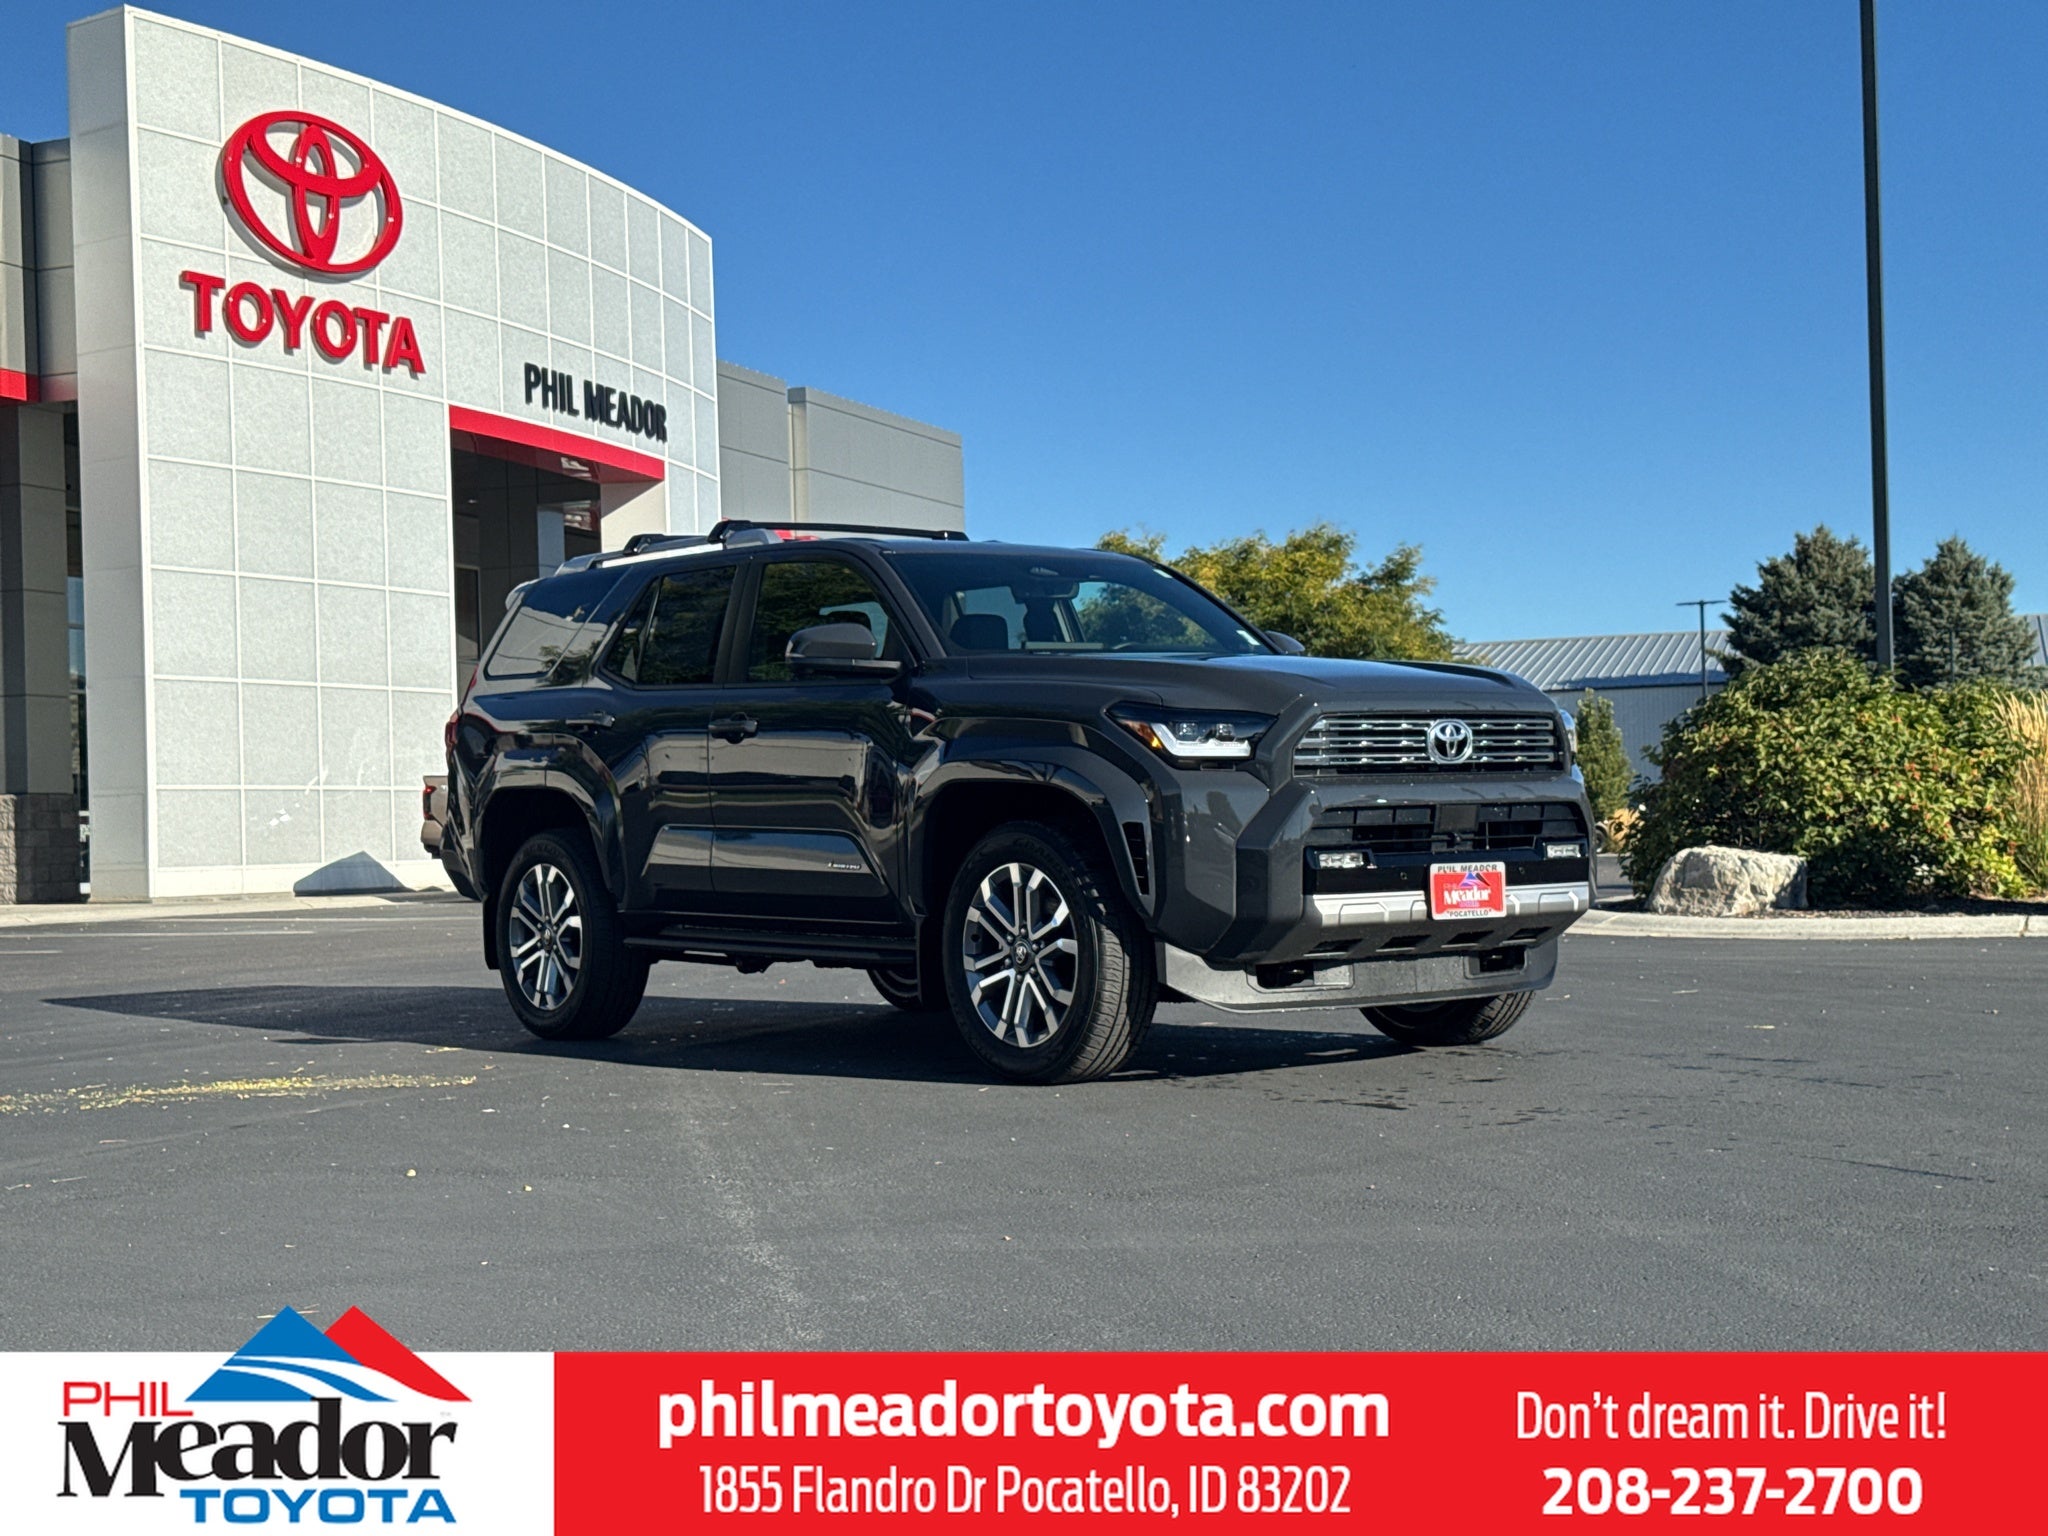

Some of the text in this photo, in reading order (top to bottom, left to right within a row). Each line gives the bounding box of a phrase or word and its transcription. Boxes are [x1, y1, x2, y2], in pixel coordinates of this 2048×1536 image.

[180, 270, 426, 375] TOYOTA
[524, 362, 668, 443] PHIL MEADOR
[1443, 885, 1492, 905] Meador
